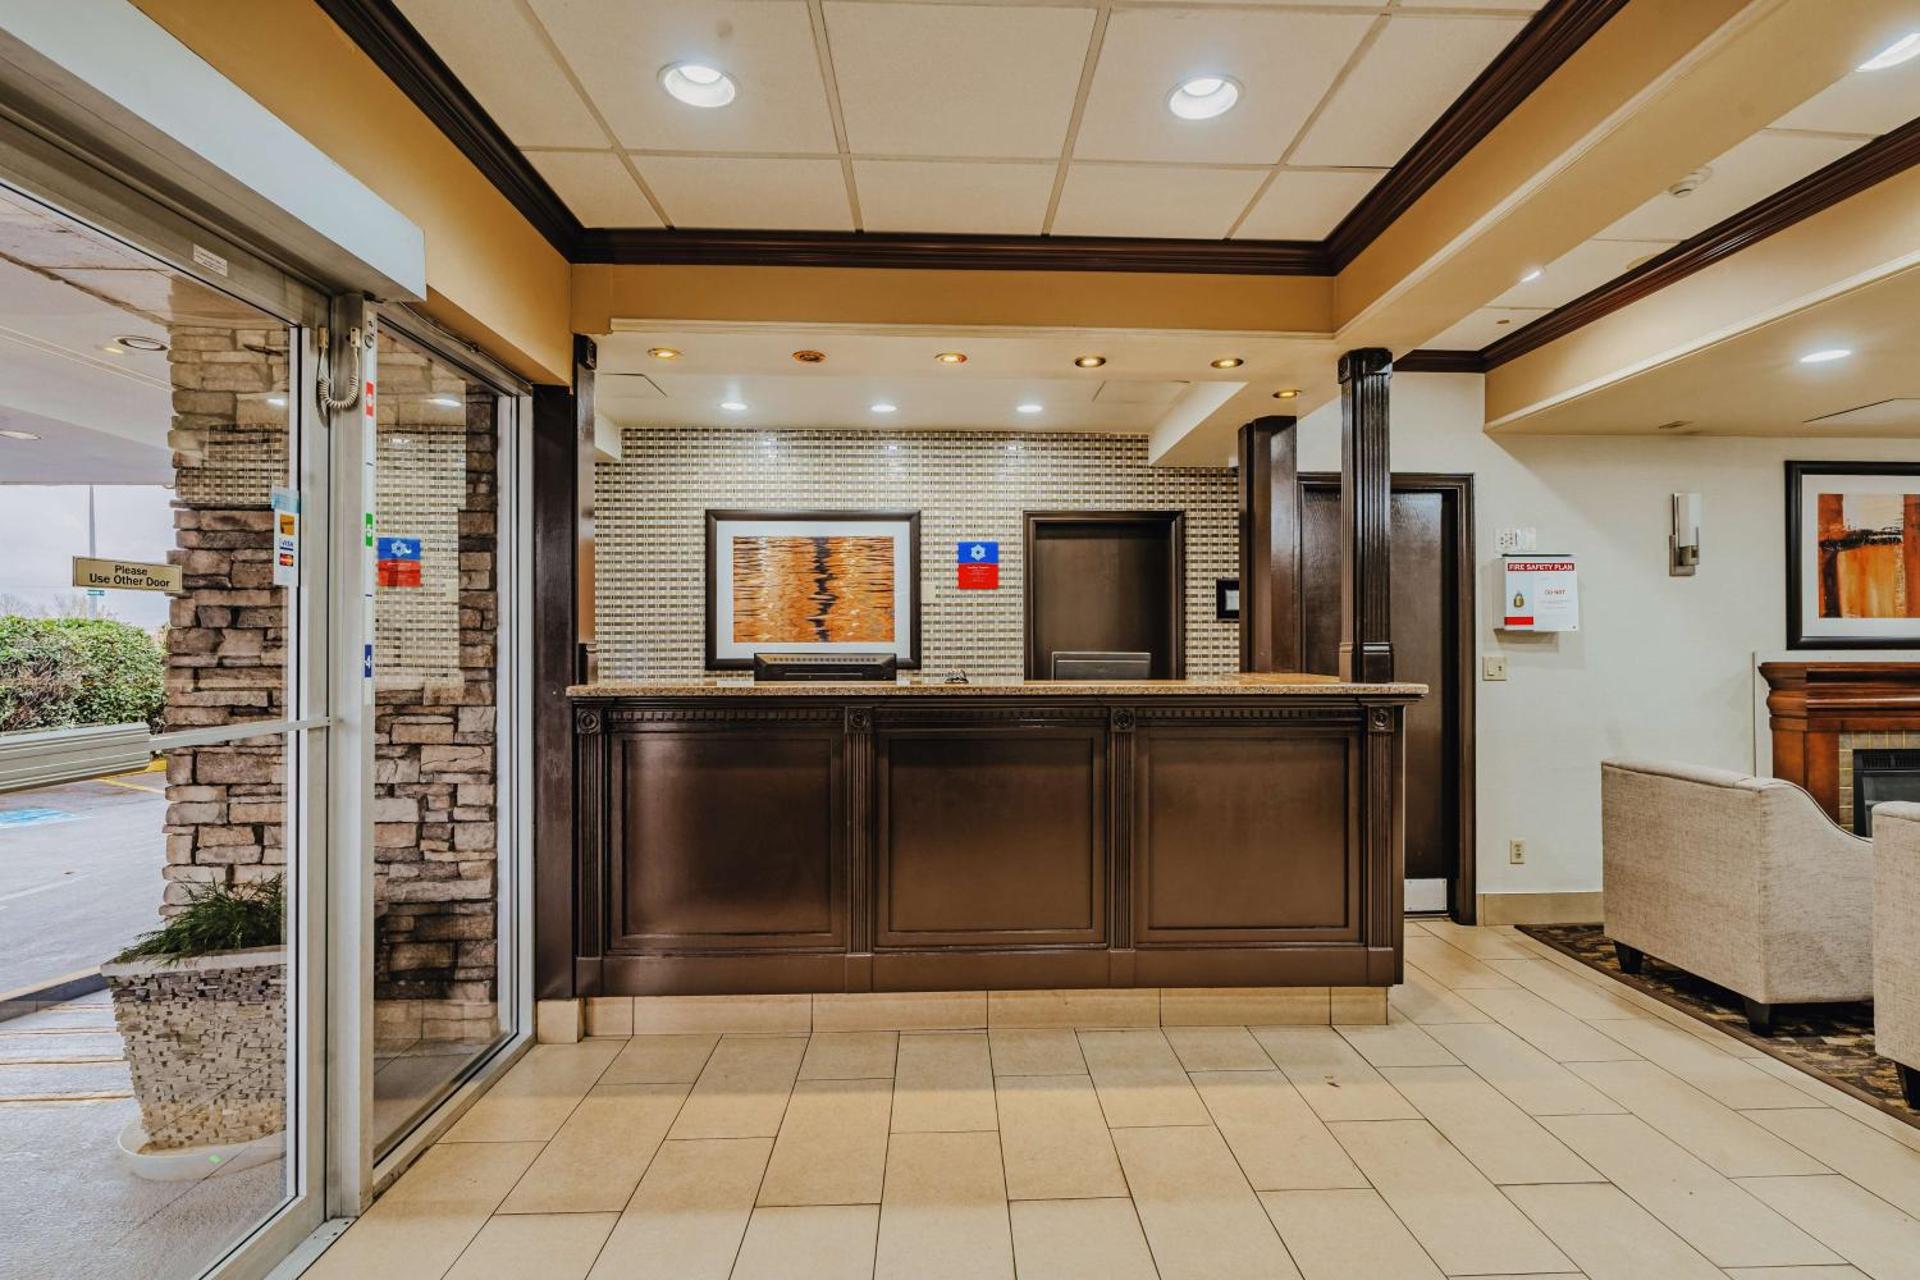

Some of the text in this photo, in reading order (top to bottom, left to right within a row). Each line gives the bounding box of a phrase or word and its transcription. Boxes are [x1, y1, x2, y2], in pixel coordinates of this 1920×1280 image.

[114, 564, 148, 576] Please
[89, 573, 170, 588] Use Other Door
